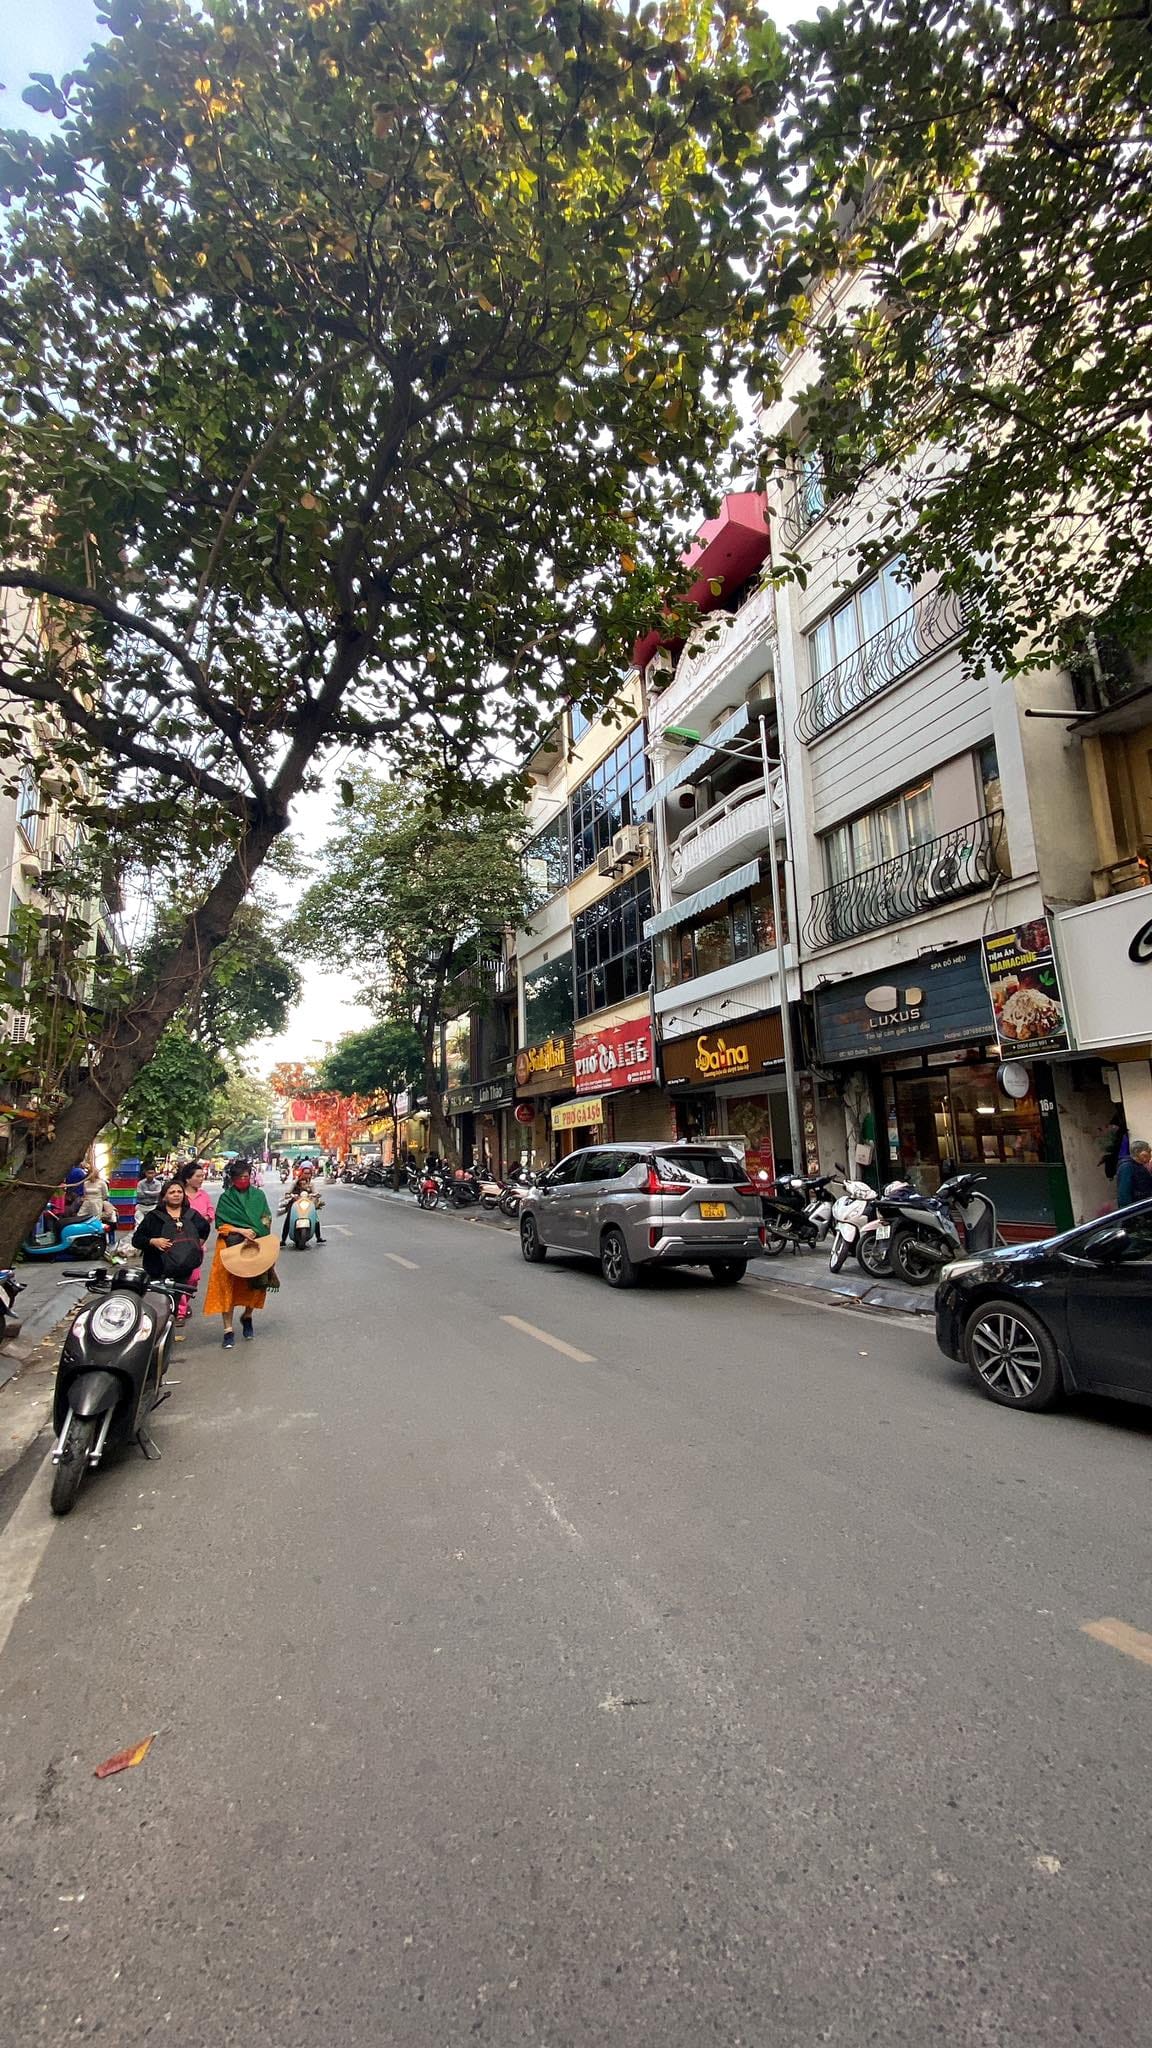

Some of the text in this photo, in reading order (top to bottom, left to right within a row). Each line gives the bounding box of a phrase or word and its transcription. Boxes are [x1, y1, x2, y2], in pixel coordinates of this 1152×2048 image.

[930, 962, 942, 970] SPA
[869, 1008, 921, 1028] LUXUS
[617, 1036, 650, 1068] 156
